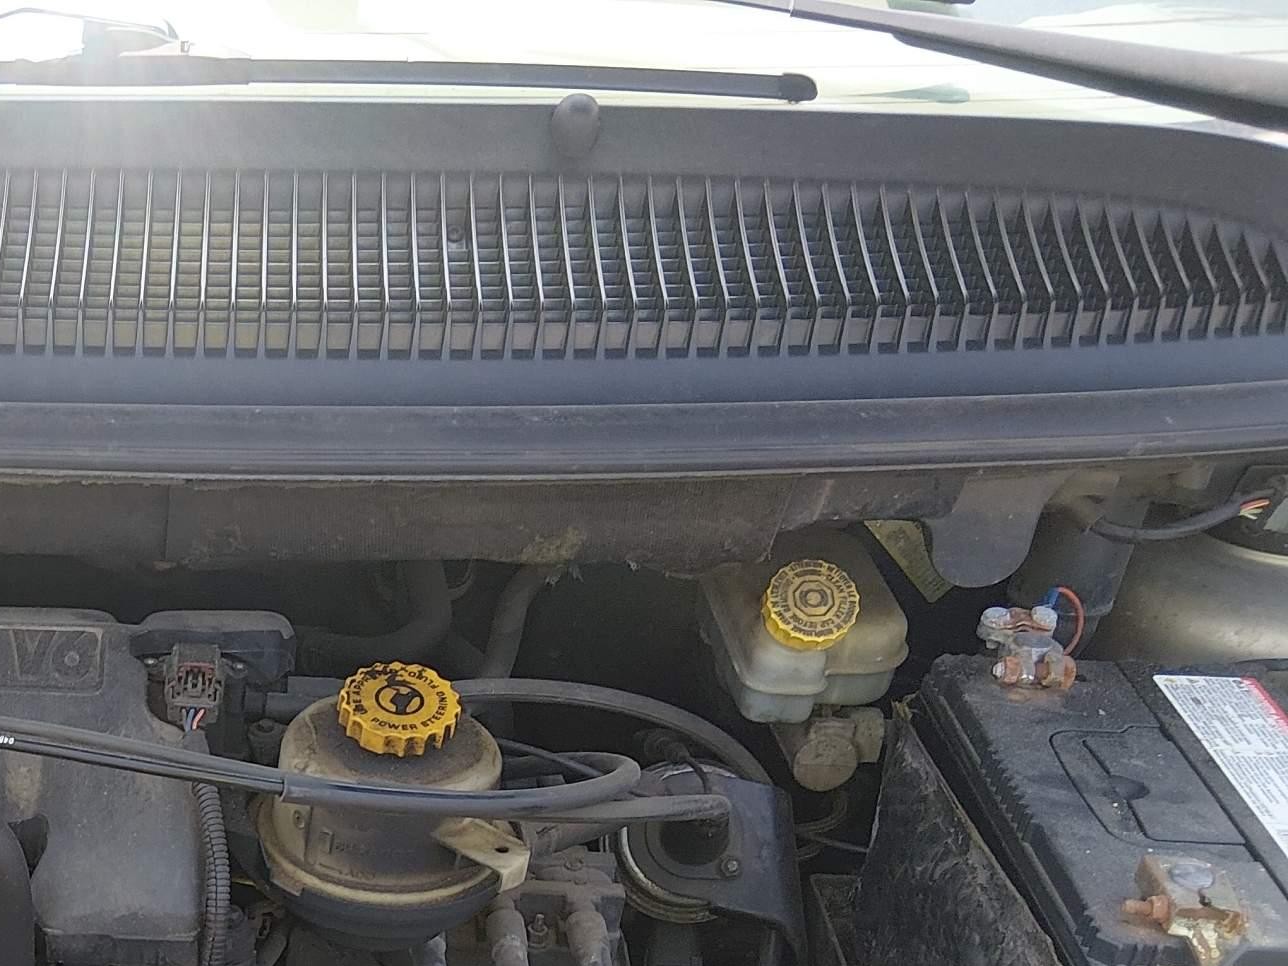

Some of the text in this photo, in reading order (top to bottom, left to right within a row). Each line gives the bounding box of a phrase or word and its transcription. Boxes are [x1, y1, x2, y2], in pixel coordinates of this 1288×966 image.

[11, 630, 93, 681] V6
[408, 671, 440, 690] FLUID
[420, 691, 448, 727] STEERING
[370, 717, 418, 731] POWER
